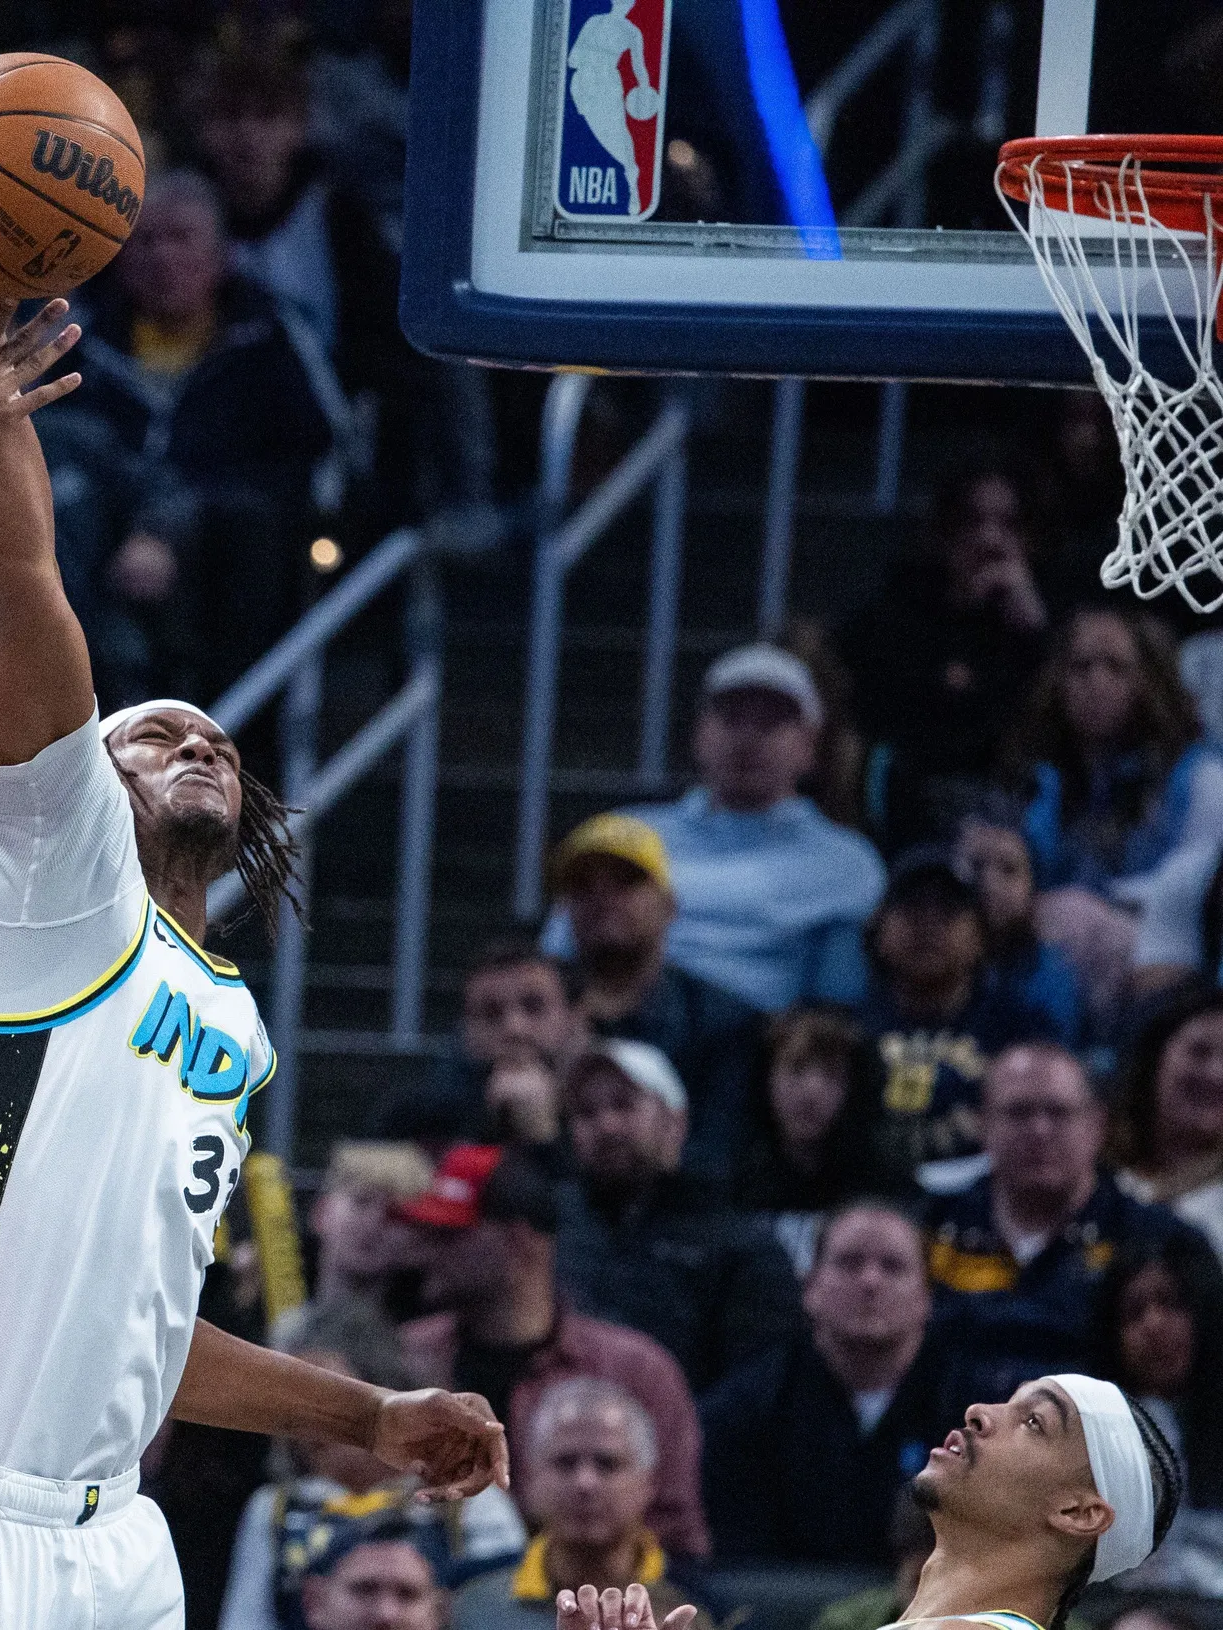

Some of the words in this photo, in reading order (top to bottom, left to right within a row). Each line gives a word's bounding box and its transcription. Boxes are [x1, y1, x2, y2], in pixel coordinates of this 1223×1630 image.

[568, 166, 617, 205] NBA
[128, 979, 250, 1137] IND
[183, 1134, 239, 1214] 3
